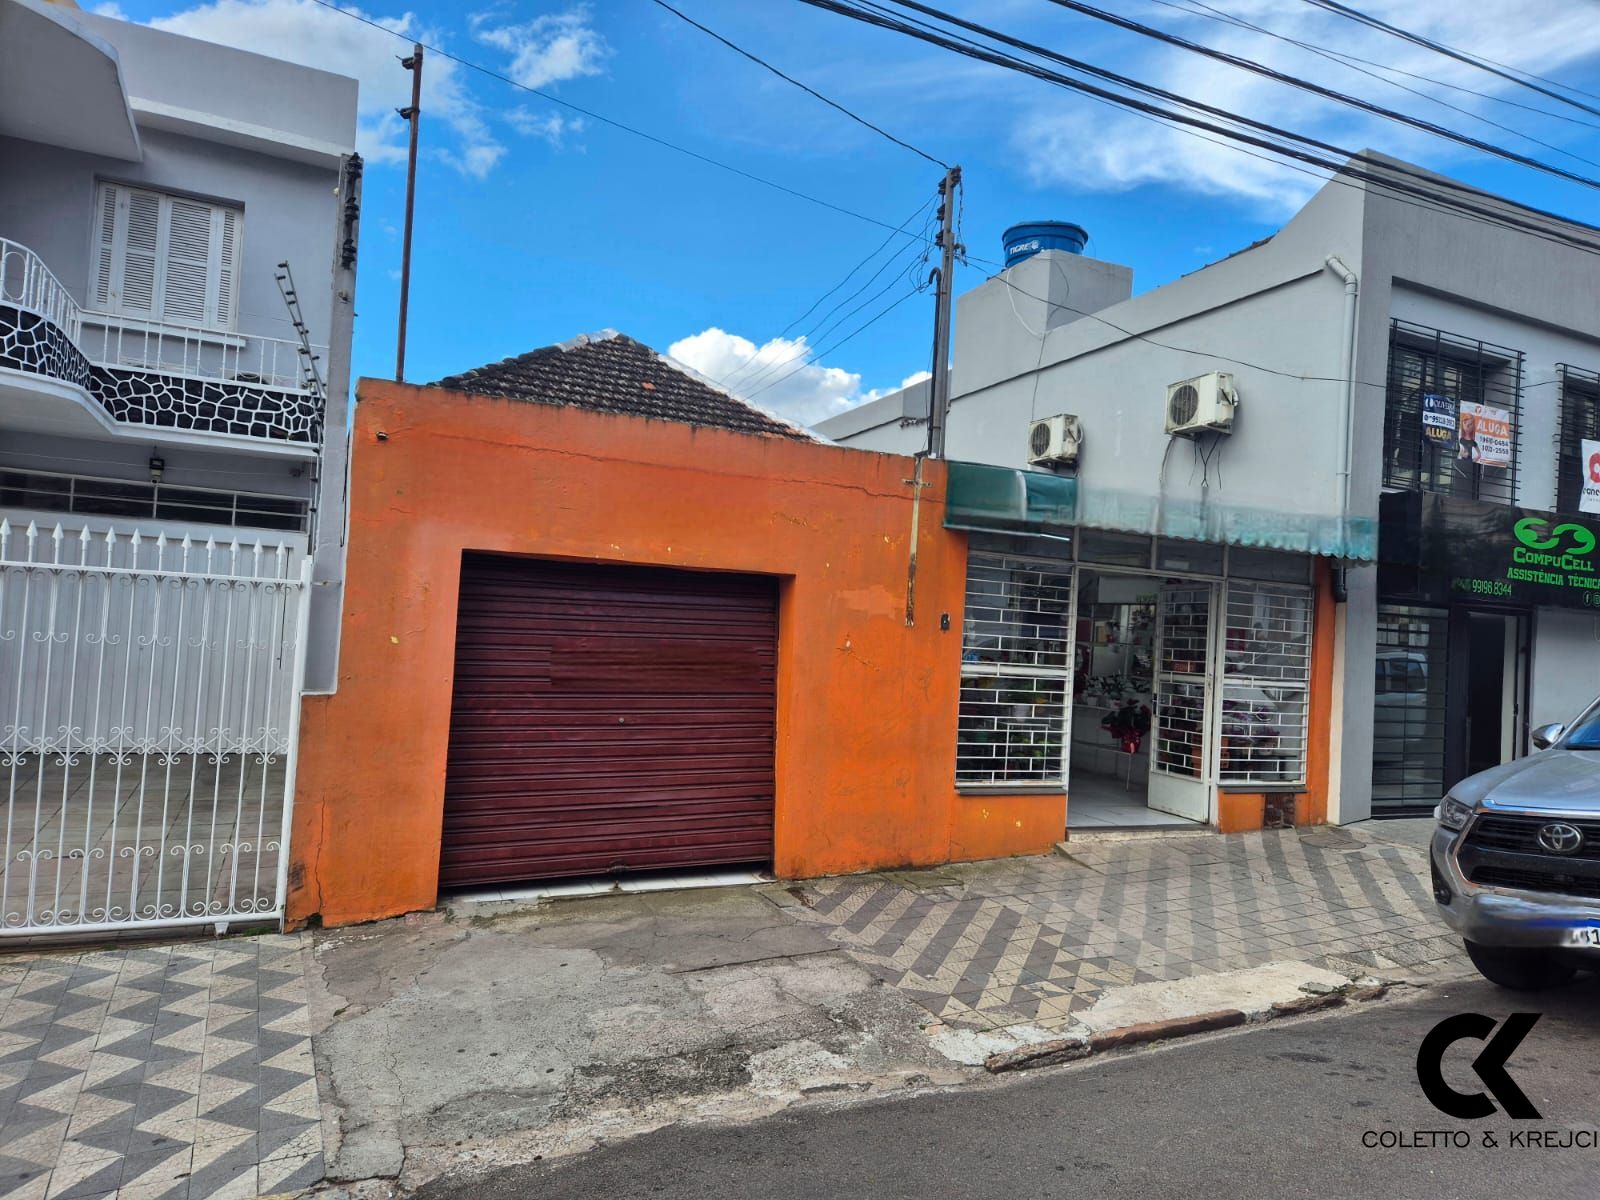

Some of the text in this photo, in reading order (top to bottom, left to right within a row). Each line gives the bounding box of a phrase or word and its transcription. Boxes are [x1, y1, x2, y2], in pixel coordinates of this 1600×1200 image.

[1010, 242, 1032, 255] TIGRE
[1425, 427, 1452, 441] ALUGA
[1477, 419, 1508, 437] ALUGA
[1507, 567, 1564, 586] ASSISTÊNCIA
